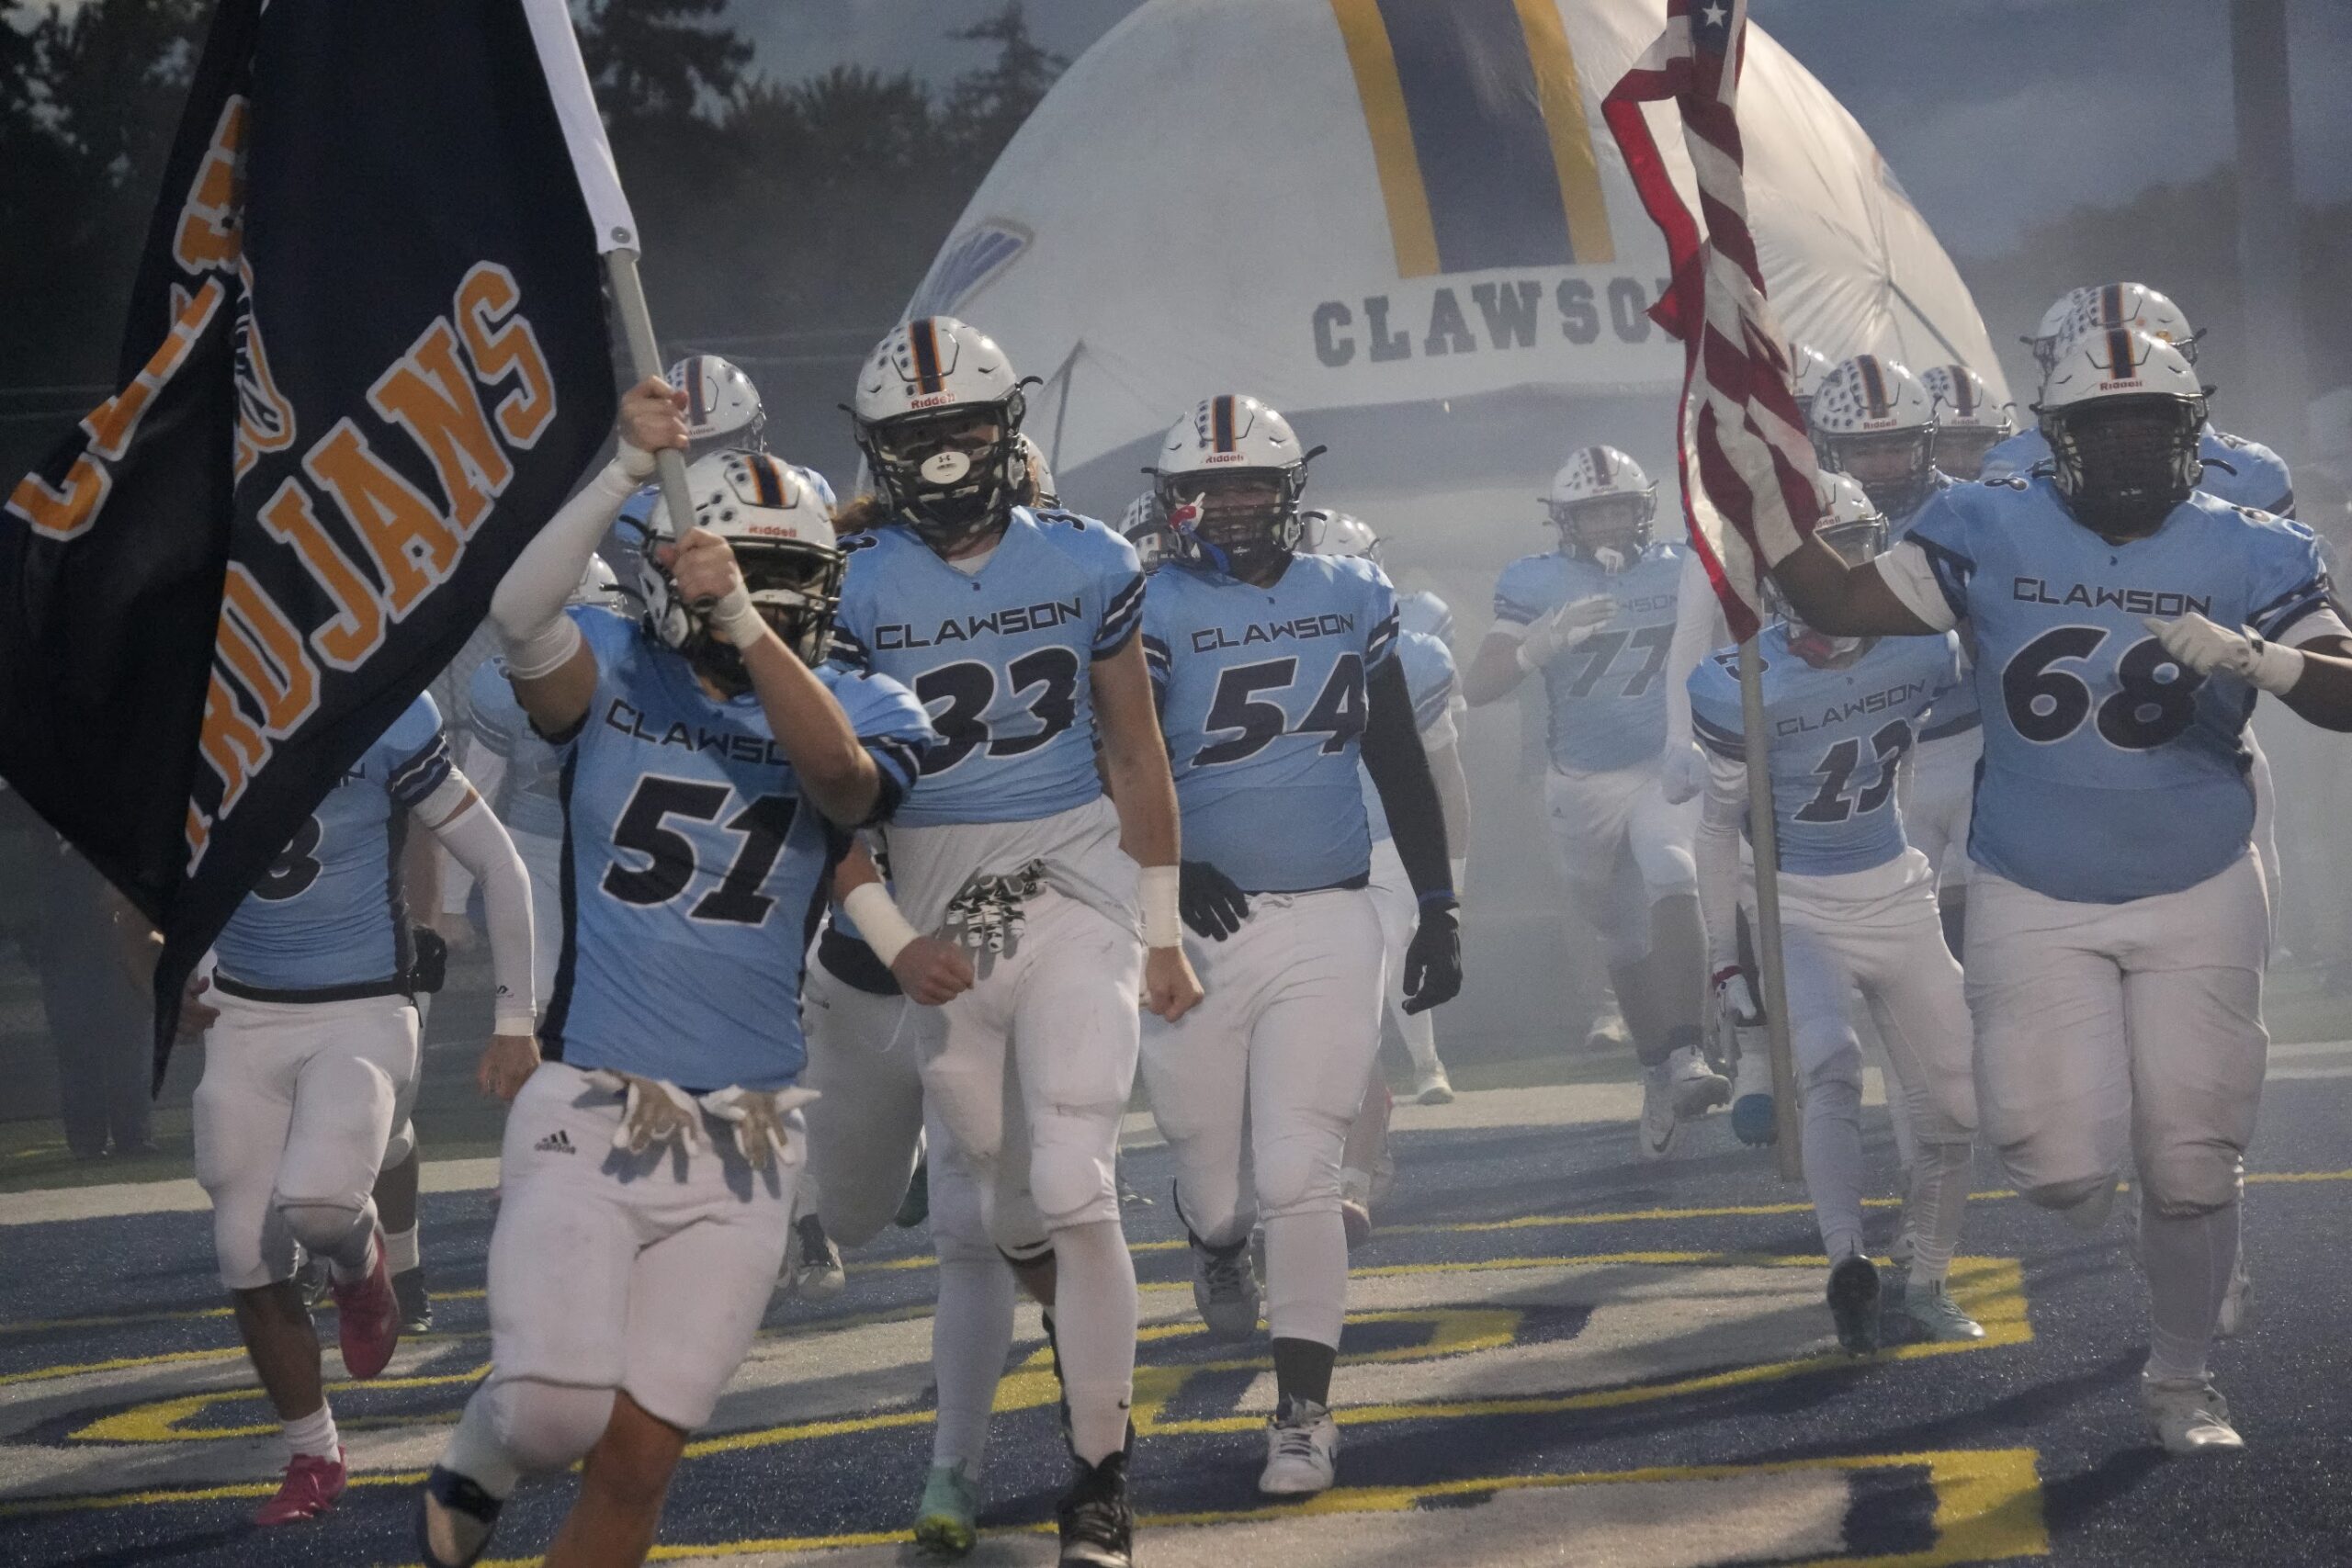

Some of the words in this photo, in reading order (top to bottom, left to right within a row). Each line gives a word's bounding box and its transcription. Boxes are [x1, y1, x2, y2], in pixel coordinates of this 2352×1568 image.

[911, 393, 956, 410] Riddell
[1205, 454, 1245, 464] Riddell
[749, 525, 797, 537] Riddell
[876, 597, 1081, 650] CLAWSON
[2014, 576, 2211, 616] CLAWSON
[1191, 613, 1353, 654] CLAWSON
[912, 645, 1080, 777] 33
[1189, 650, 1369, 769] 54
[1776, 679, 1926, 737] CLAWSON
[2001, 624, 2211, 752] 68
[605, 697, 790, 766] CLAWSO
[599, 772, 799, 928] 51
